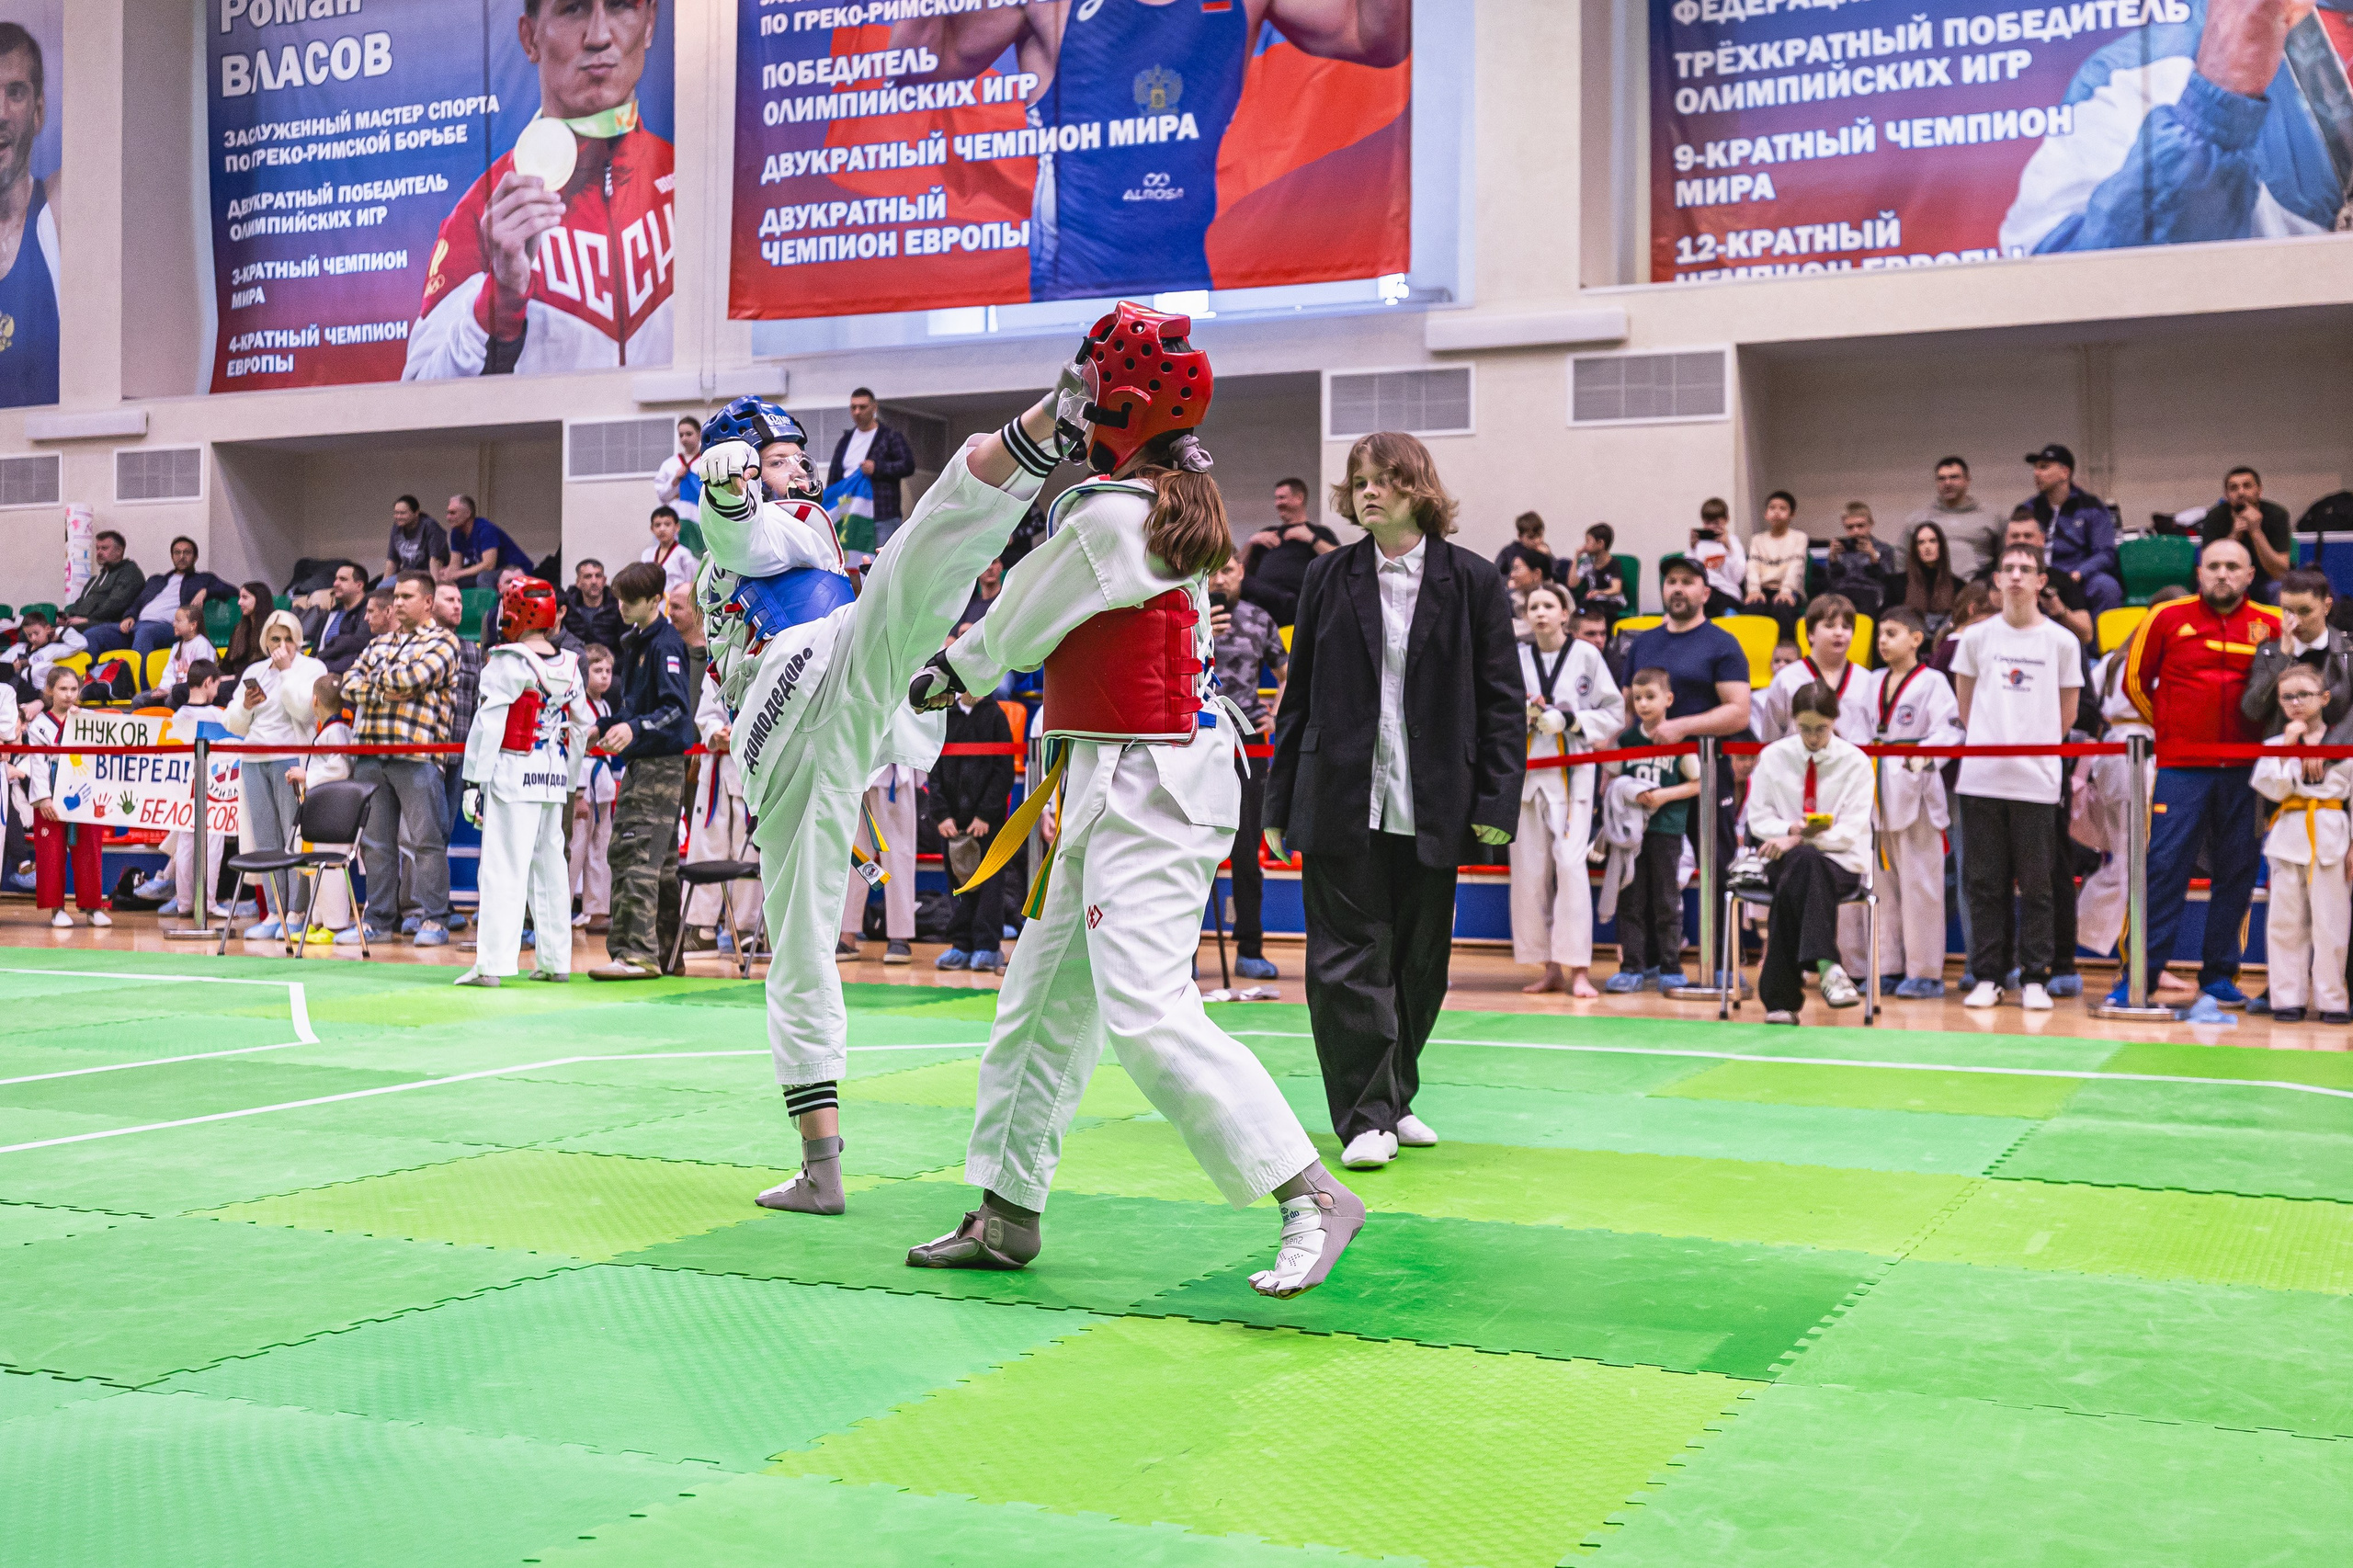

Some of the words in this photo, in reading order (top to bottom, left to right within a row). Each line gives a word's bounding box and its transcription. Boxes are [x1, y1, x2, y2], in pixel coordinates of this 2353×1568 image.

[760, 14, 788, 36] ПО
[1674, 13, 1934, 79] ТРЁХКРАТНЫЙ
[1943, 0, 2191, 47] ПОБЕДИТЕЛЬ
[222, 31, 393, 97] ВЛАСОВ
[762, 46, 938, 90] ПОБЕДИТЕЛЬ
[1675, 57, 1954, 114] ОЛИМПИЙСКИХ
[1961, 49, 2033, 85] ИГР
[223, 108, 352, 149] ЗАСЛУЖЕННЫЙ
[355, 104, 425, 131] МАСТЕР
[428, 95, 500, 120] СПОРТА
[763, 78, 978, 127] ОЛИМПИЙСКИХ
[982, 73, 1039, 104] ИГР
[225, 153, 250, 173] ПО
[251, 129, 392, 168] ГРЕКО-РИМСКОЙ
[394, 123, 469, 151] БОРЬБЕ
[760, 131, 948, 184] ДВУКРАТНЫЙ
[952, 119, 1102, 161] ЧЕМПИОН
[1108, 112, 1200, 147] МИРА
[1674, 116, 1877, 172] 9-КРАТНЫЙ
[1884, 104, 2074, 150] ЧЕМПИОН
[227, 182, 334, 222] ДВУКРАТНЫЙ
[337, 173, 449, 203] ПОБЕДИТЕЛЬ
[758, 187, 948, 238] ДВУКРАТНЫЙ
[1675, 172, 1778, 209] МИРА
[229, 210, 353, 242] ОЛИМПИЙСКИХ
[356, 205, 389, 227] ИГР
[760, 233, 898, 267] ЧЕМПИОН
[904, 221, 1030, 256] ЕВРОПЫ
[1674, 210, 1902, 265] 12-КРАТНЫЙ
[232, 254, 321, 286] 3-КРАТНЫЙ
[323, 249, 409, 275] ЧЕМПИОН
[231, 285, 267, 310] МИРА
[228, 323, 321, 353] 4-КРАТНЫЙ
[324, 320, 409, 346] ЧЕМПИОН
[226, 353, 294, 378] ЕВРОПЫ
[74, 719, 148, 746] ЖУКОВ
[95, 753, 190, 784] ВПЕРЁД!
[140, 798, 239, 833] БЕЛОСОВ
